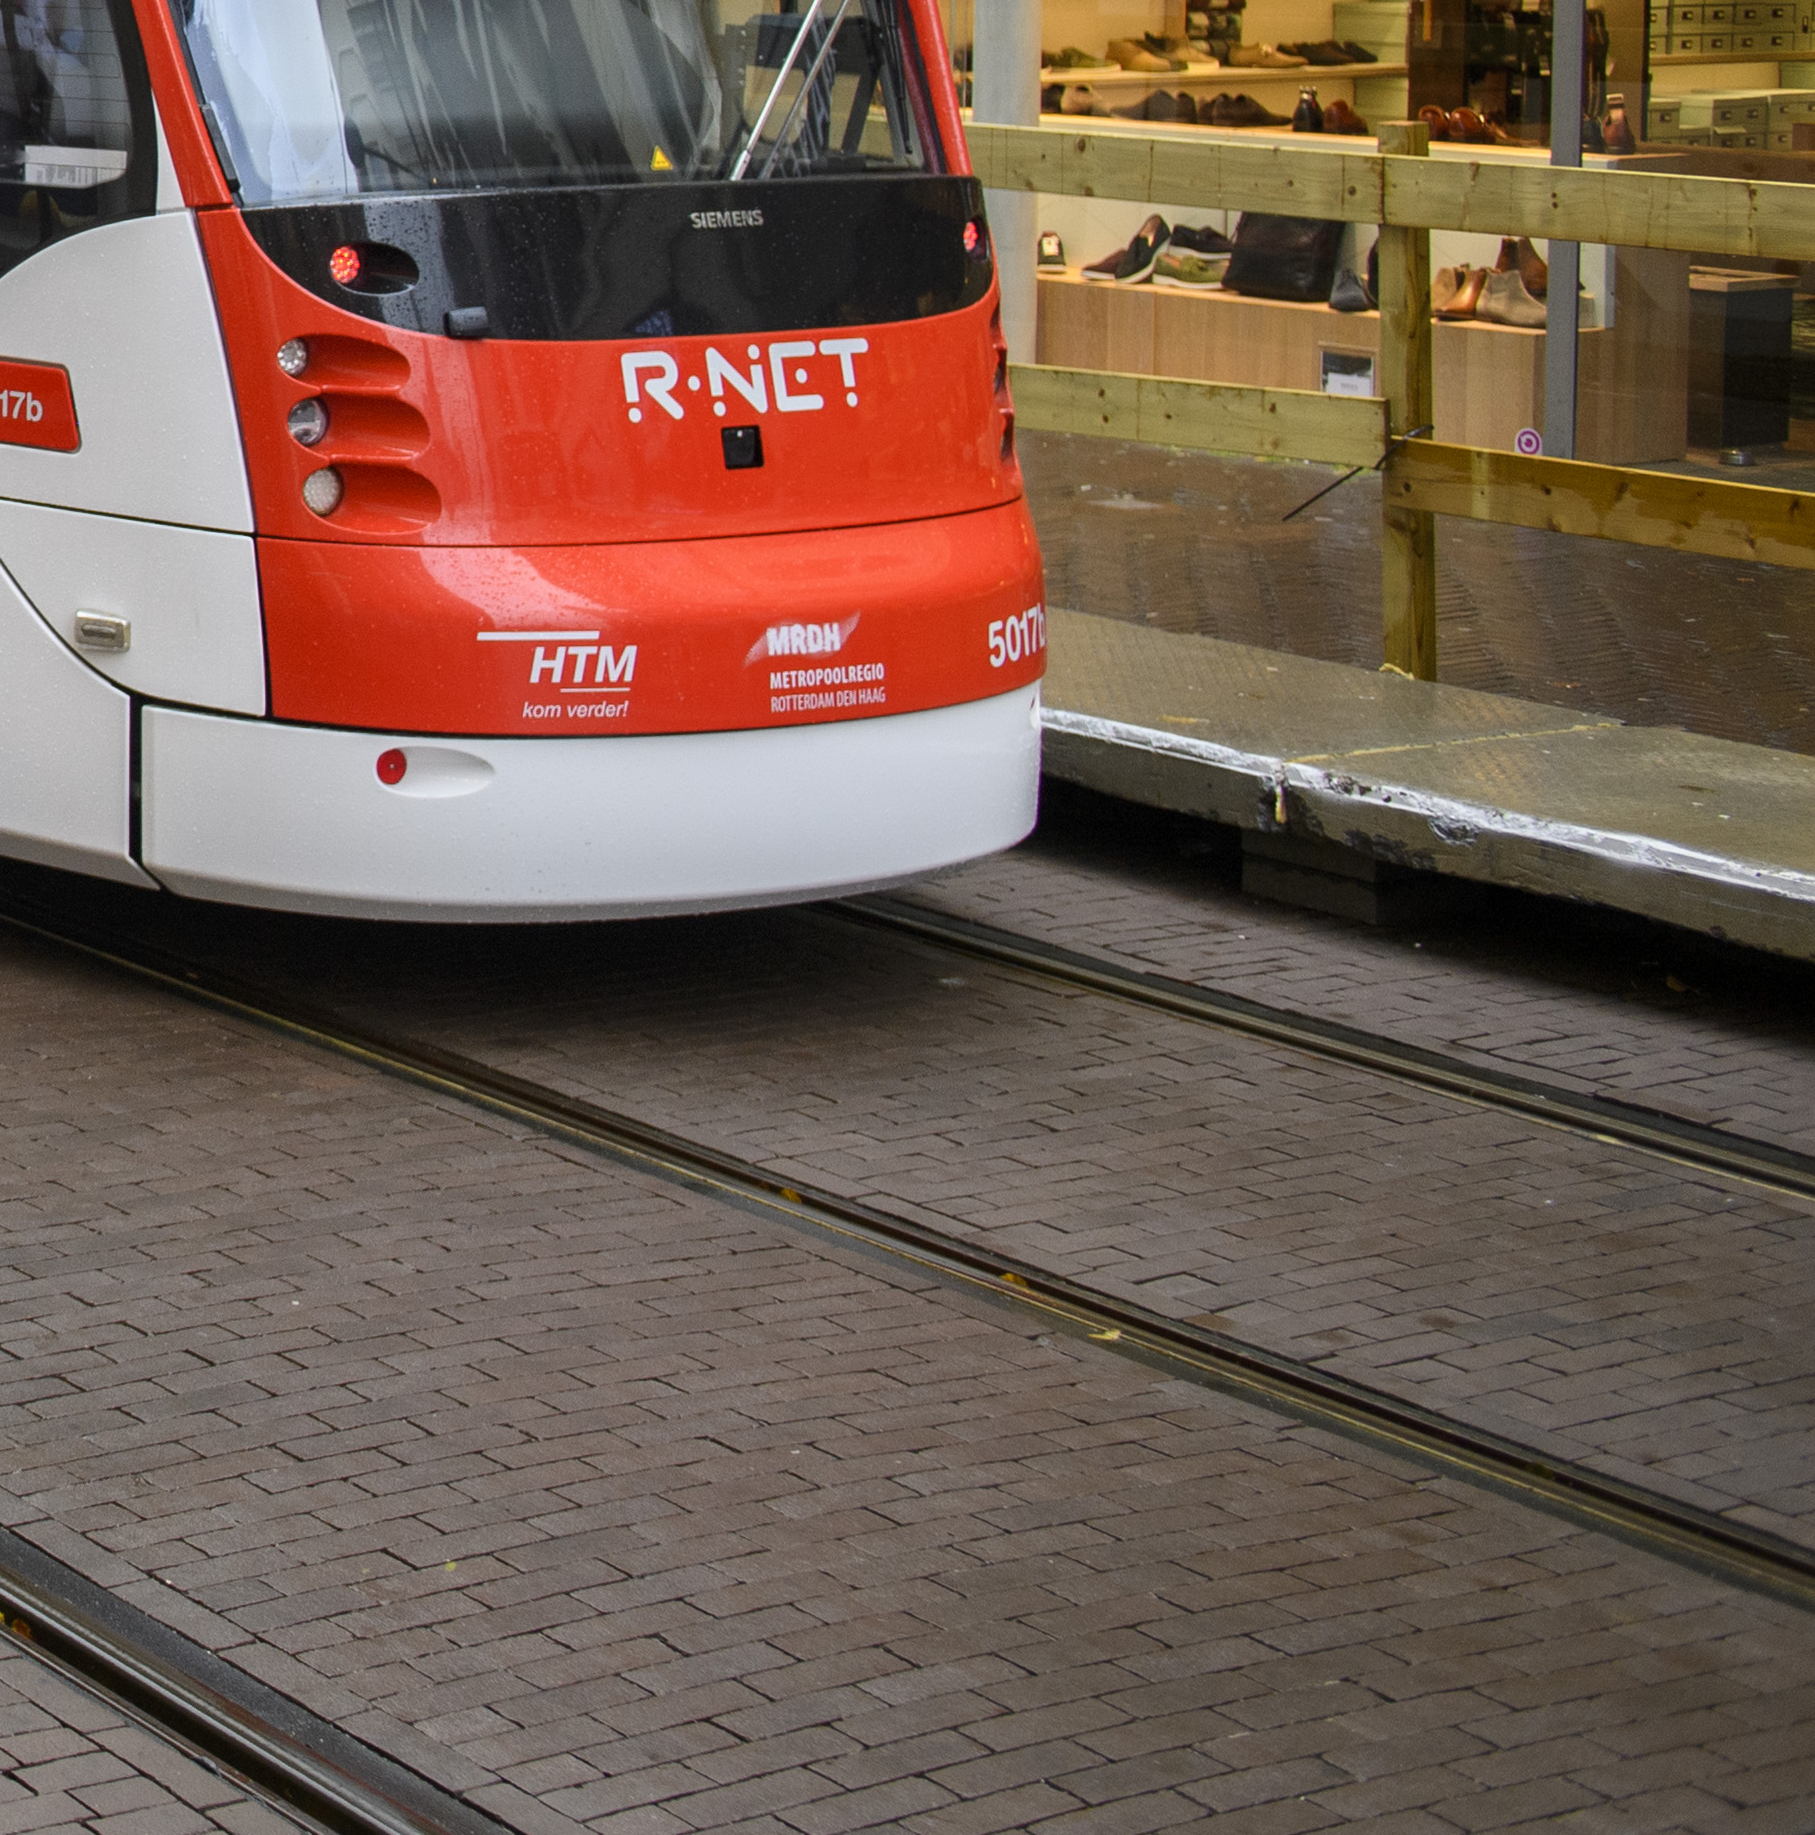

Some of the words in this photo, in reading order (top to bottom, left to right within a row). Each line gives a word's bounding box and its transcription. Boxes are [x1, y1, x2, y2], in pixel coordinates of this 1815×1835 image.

[689, 208, 765, 229] SIEMENS
[766, 621, 842, 656] MRDH
[529, 645, 638, 684] HTM
[770, 663, 885, 690] METROPOOLREGIO
[522, 701, 562, 719] kom
[566, 700, 630, 718] verder!
[771, 692, 835, 713] ROTTERDAM
[836, 690, 857, 707] DEN
[858, 687, 886, 705] HAAG
